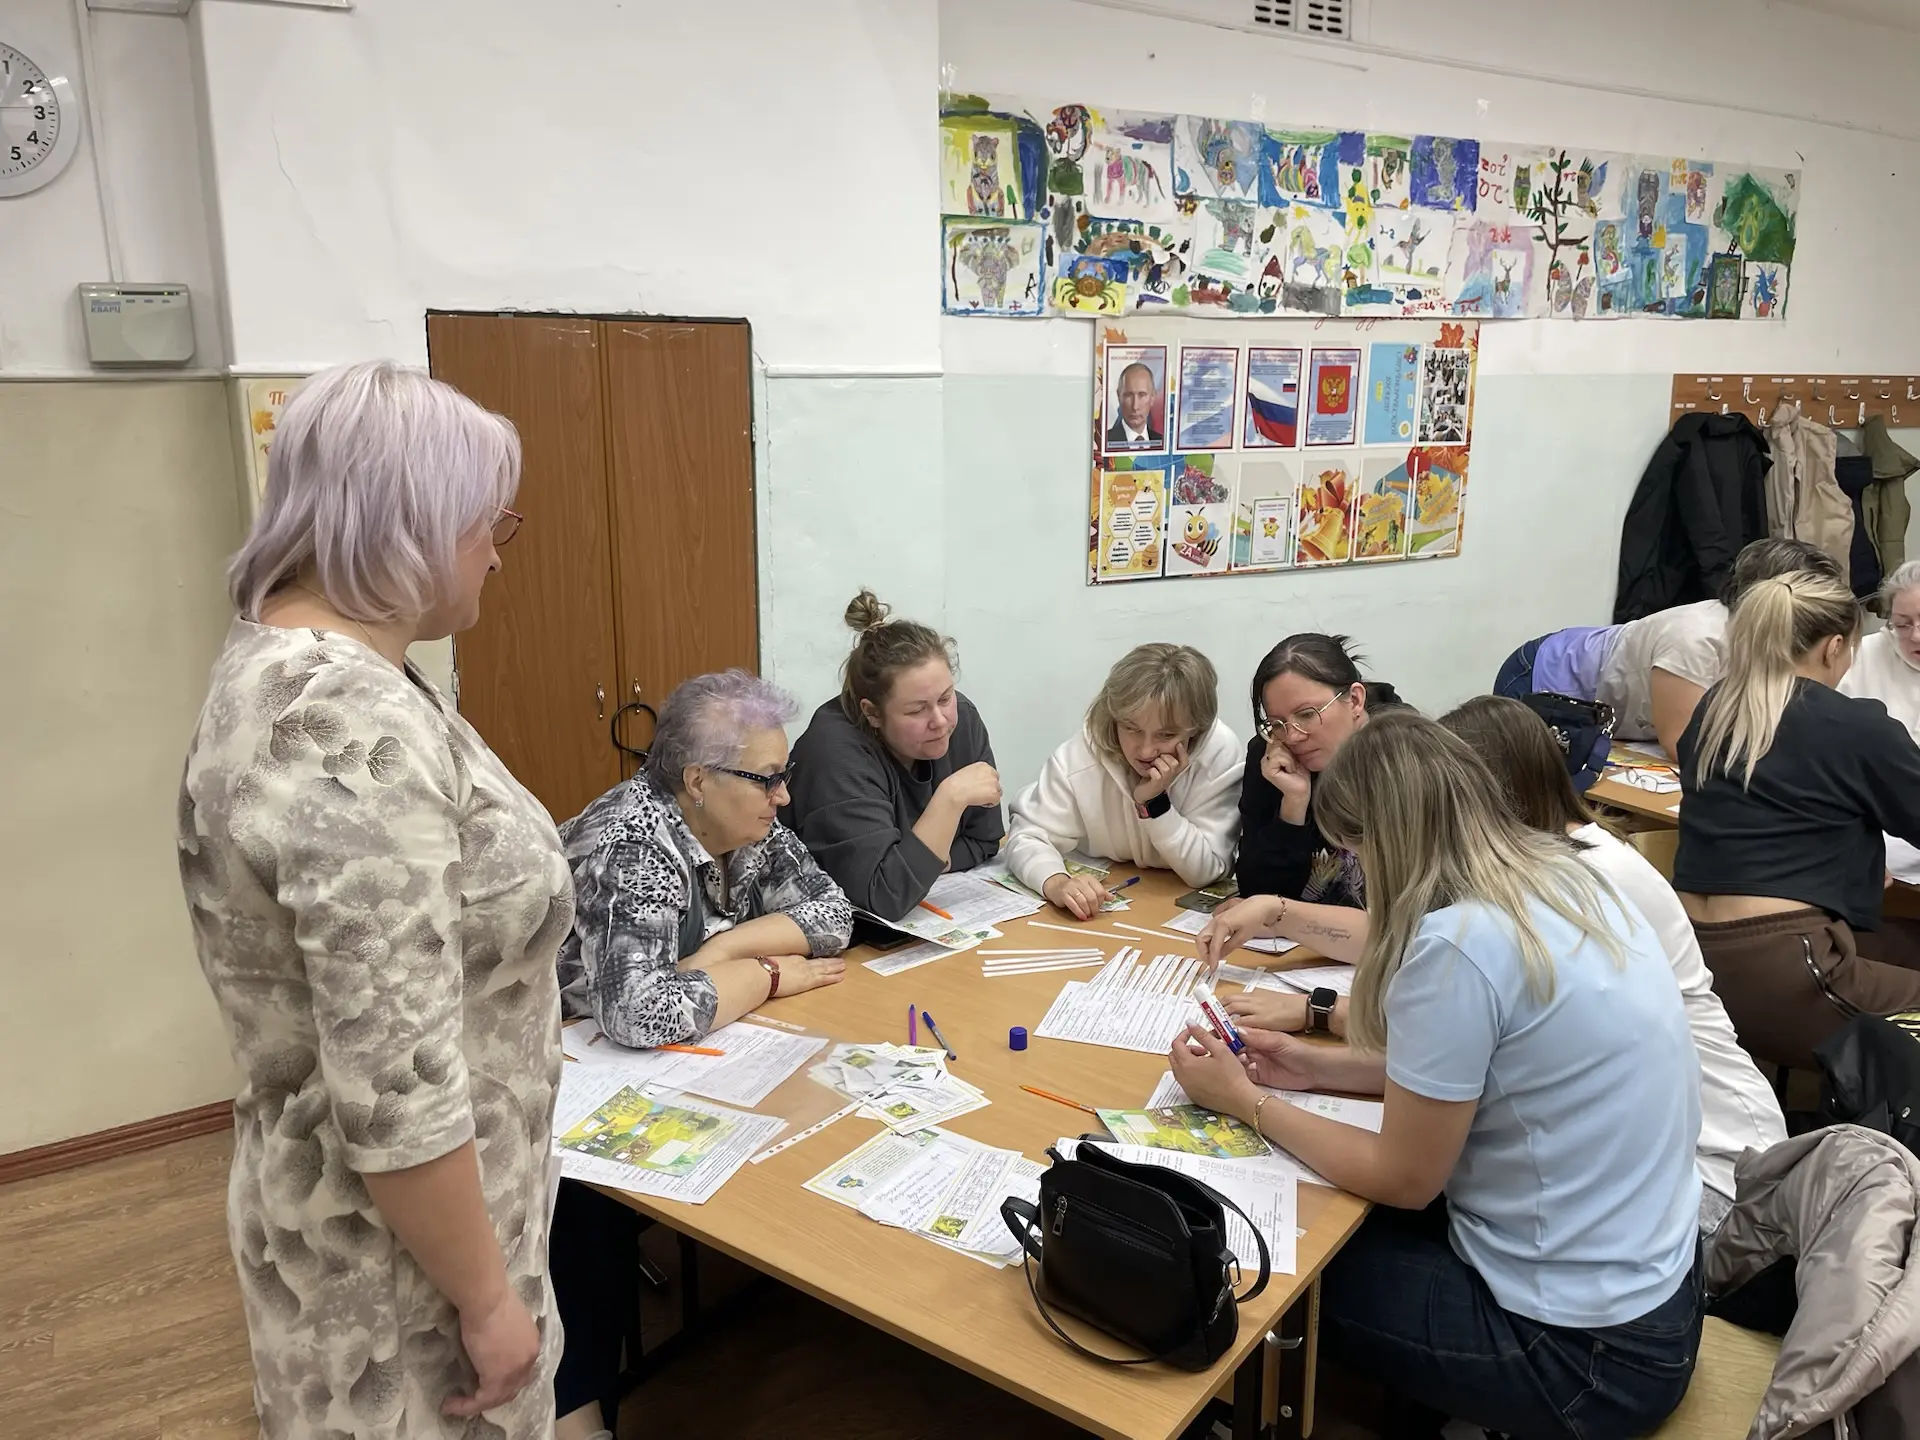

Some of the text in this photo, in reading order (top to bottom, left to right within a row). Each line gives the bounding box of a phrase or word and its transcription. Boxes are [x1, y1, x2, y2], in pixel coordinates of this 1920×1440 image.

[2, 60, 10, 74] 1
[22, 80, 35, 95] 2
[34, 106, 45, 120] 3
[27, 131, 39, 144] 4
[10, 146, 21, 161] 5
[91, 305, 121, 313] КВАРЦ
